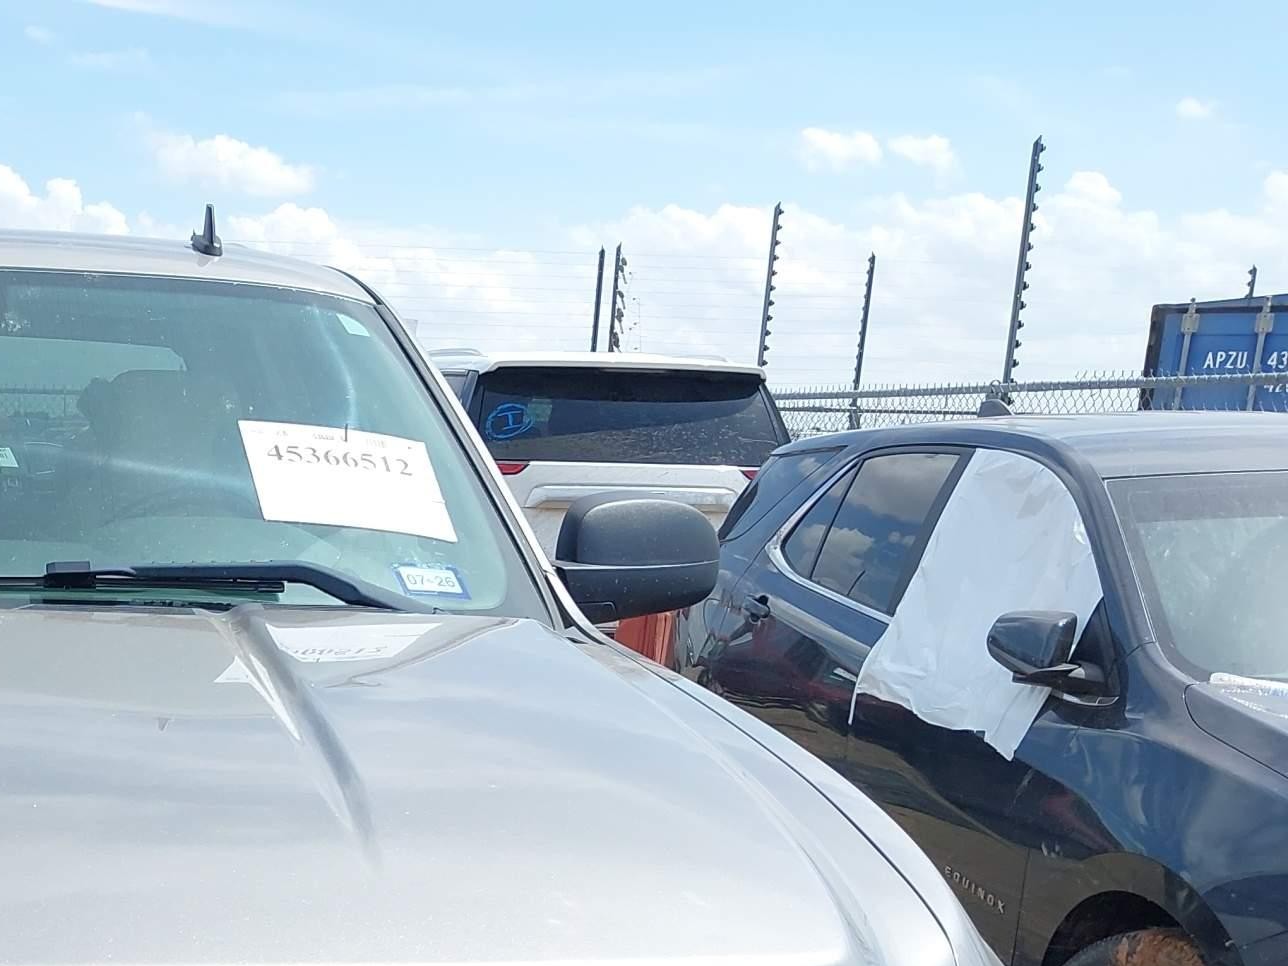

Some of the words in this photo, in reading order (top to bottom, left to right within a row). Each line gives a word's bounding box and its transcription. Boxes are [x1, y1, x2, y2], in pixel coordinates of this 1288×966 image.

[1203, 351, 1248, 369] APZU
[267, 444, 413, 476] 45366512
[944, 865, 1005, 914] EQUINOX
